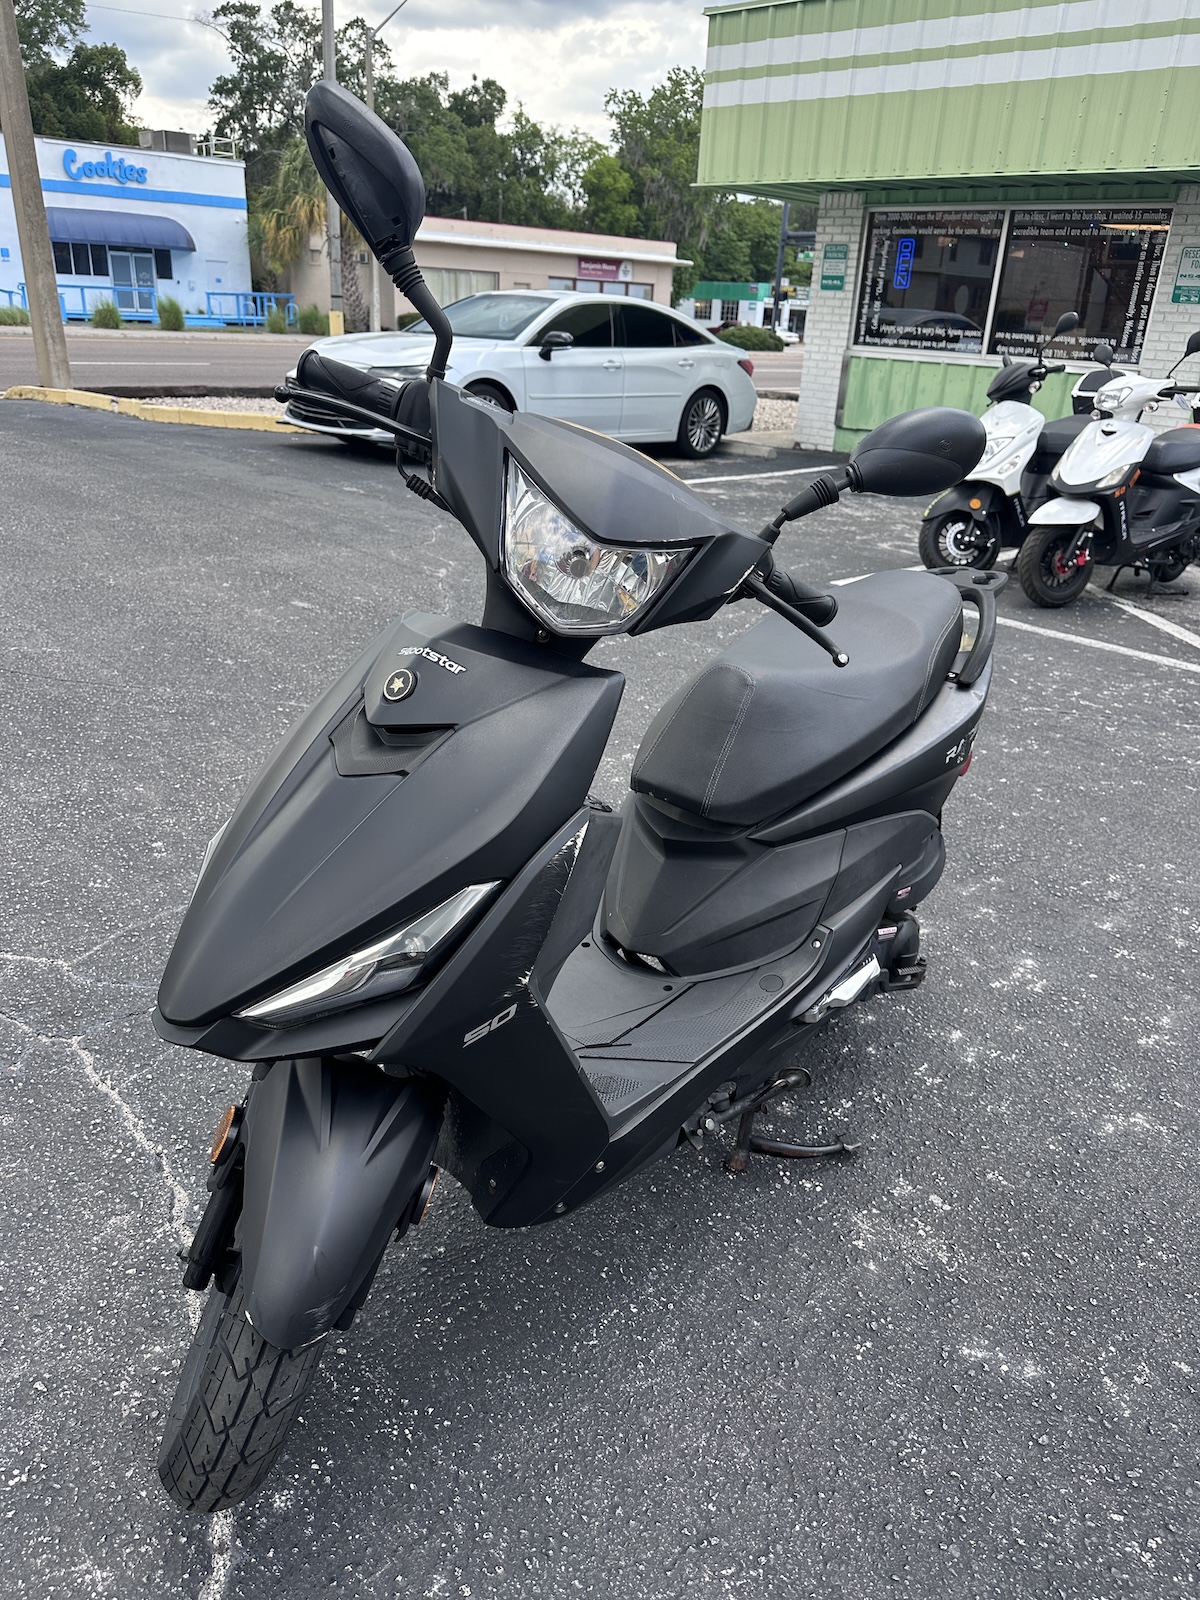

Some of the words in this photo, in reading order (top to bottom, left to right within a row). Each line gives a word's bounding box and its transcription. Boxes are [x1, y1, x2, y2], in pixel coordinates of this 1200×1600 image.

[63, 148, 147, 184] Cookies
[1072, 211, 1081, 220] the
[1082, 211, 1093, 220] bus
[1142, 211, 1168, 220] minutes
[1055, 226, 1066, 236] and
[897, 242, 911, 286] OPEN
[1135, 262, 1144, 281] entire
[1150, 260, 1160, 276] Then
[1144, 283, 1156, 302] drove
[1012, 332, 1035, 344] Welcome
[1120, 320, 1134, 348] Welcome
[397, 646, 467, 674] scootstar
[462, 1002, 518, 1049] 50
